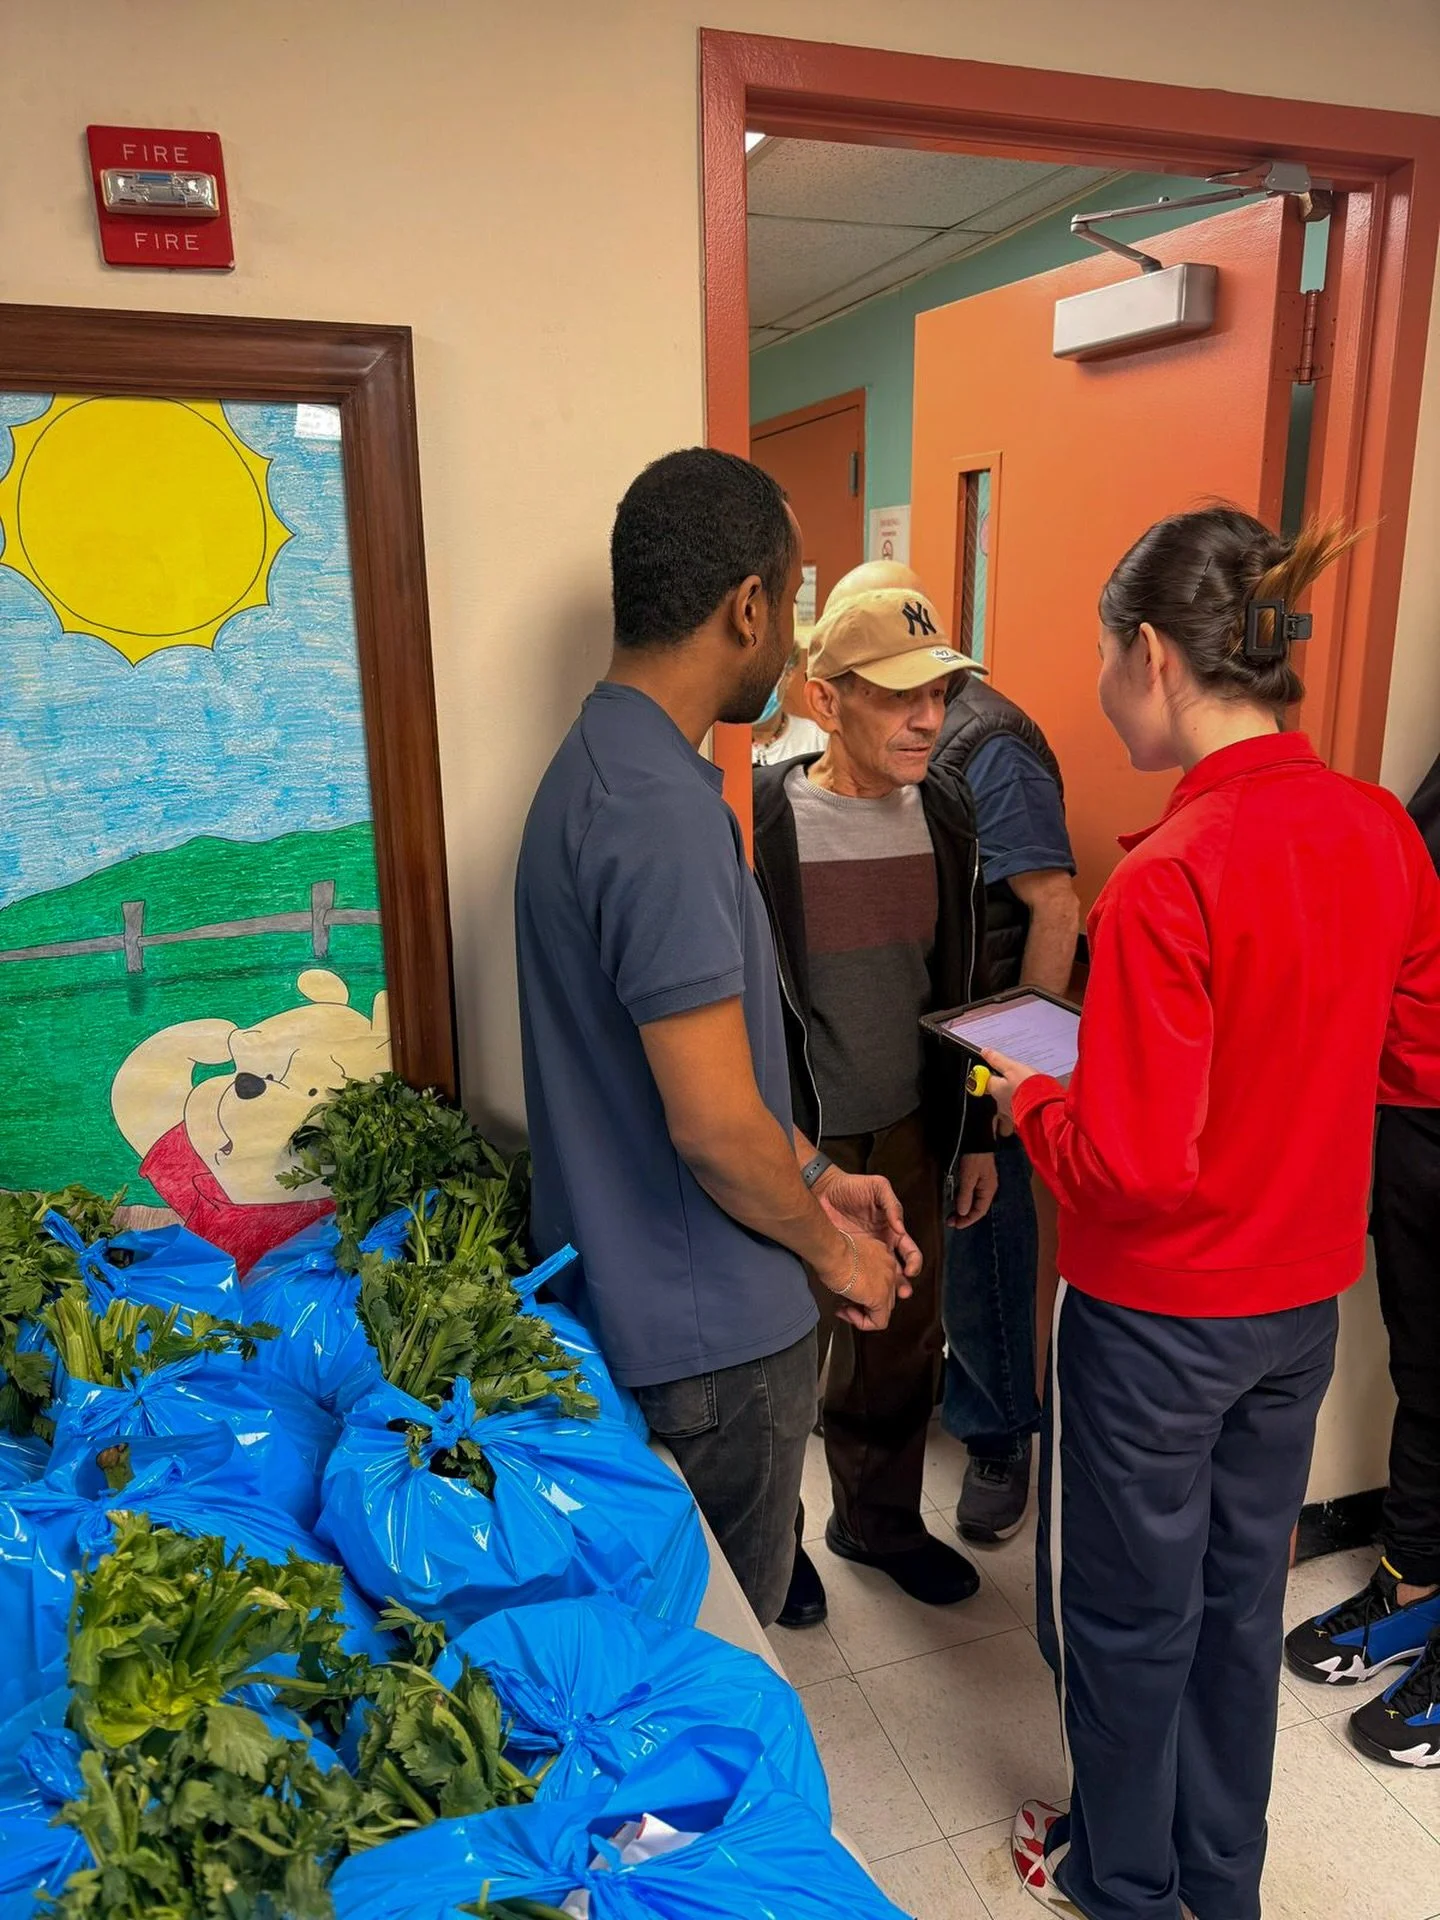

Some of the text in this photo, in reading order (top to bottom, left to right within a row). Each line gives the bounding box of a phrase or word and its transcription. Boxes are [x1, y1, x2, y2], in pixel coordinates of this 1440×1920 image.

[122, 143, 189, 164] FIRE
[134, 232, 199, 250] FIRE
[902, 601, 937, 636] NY
